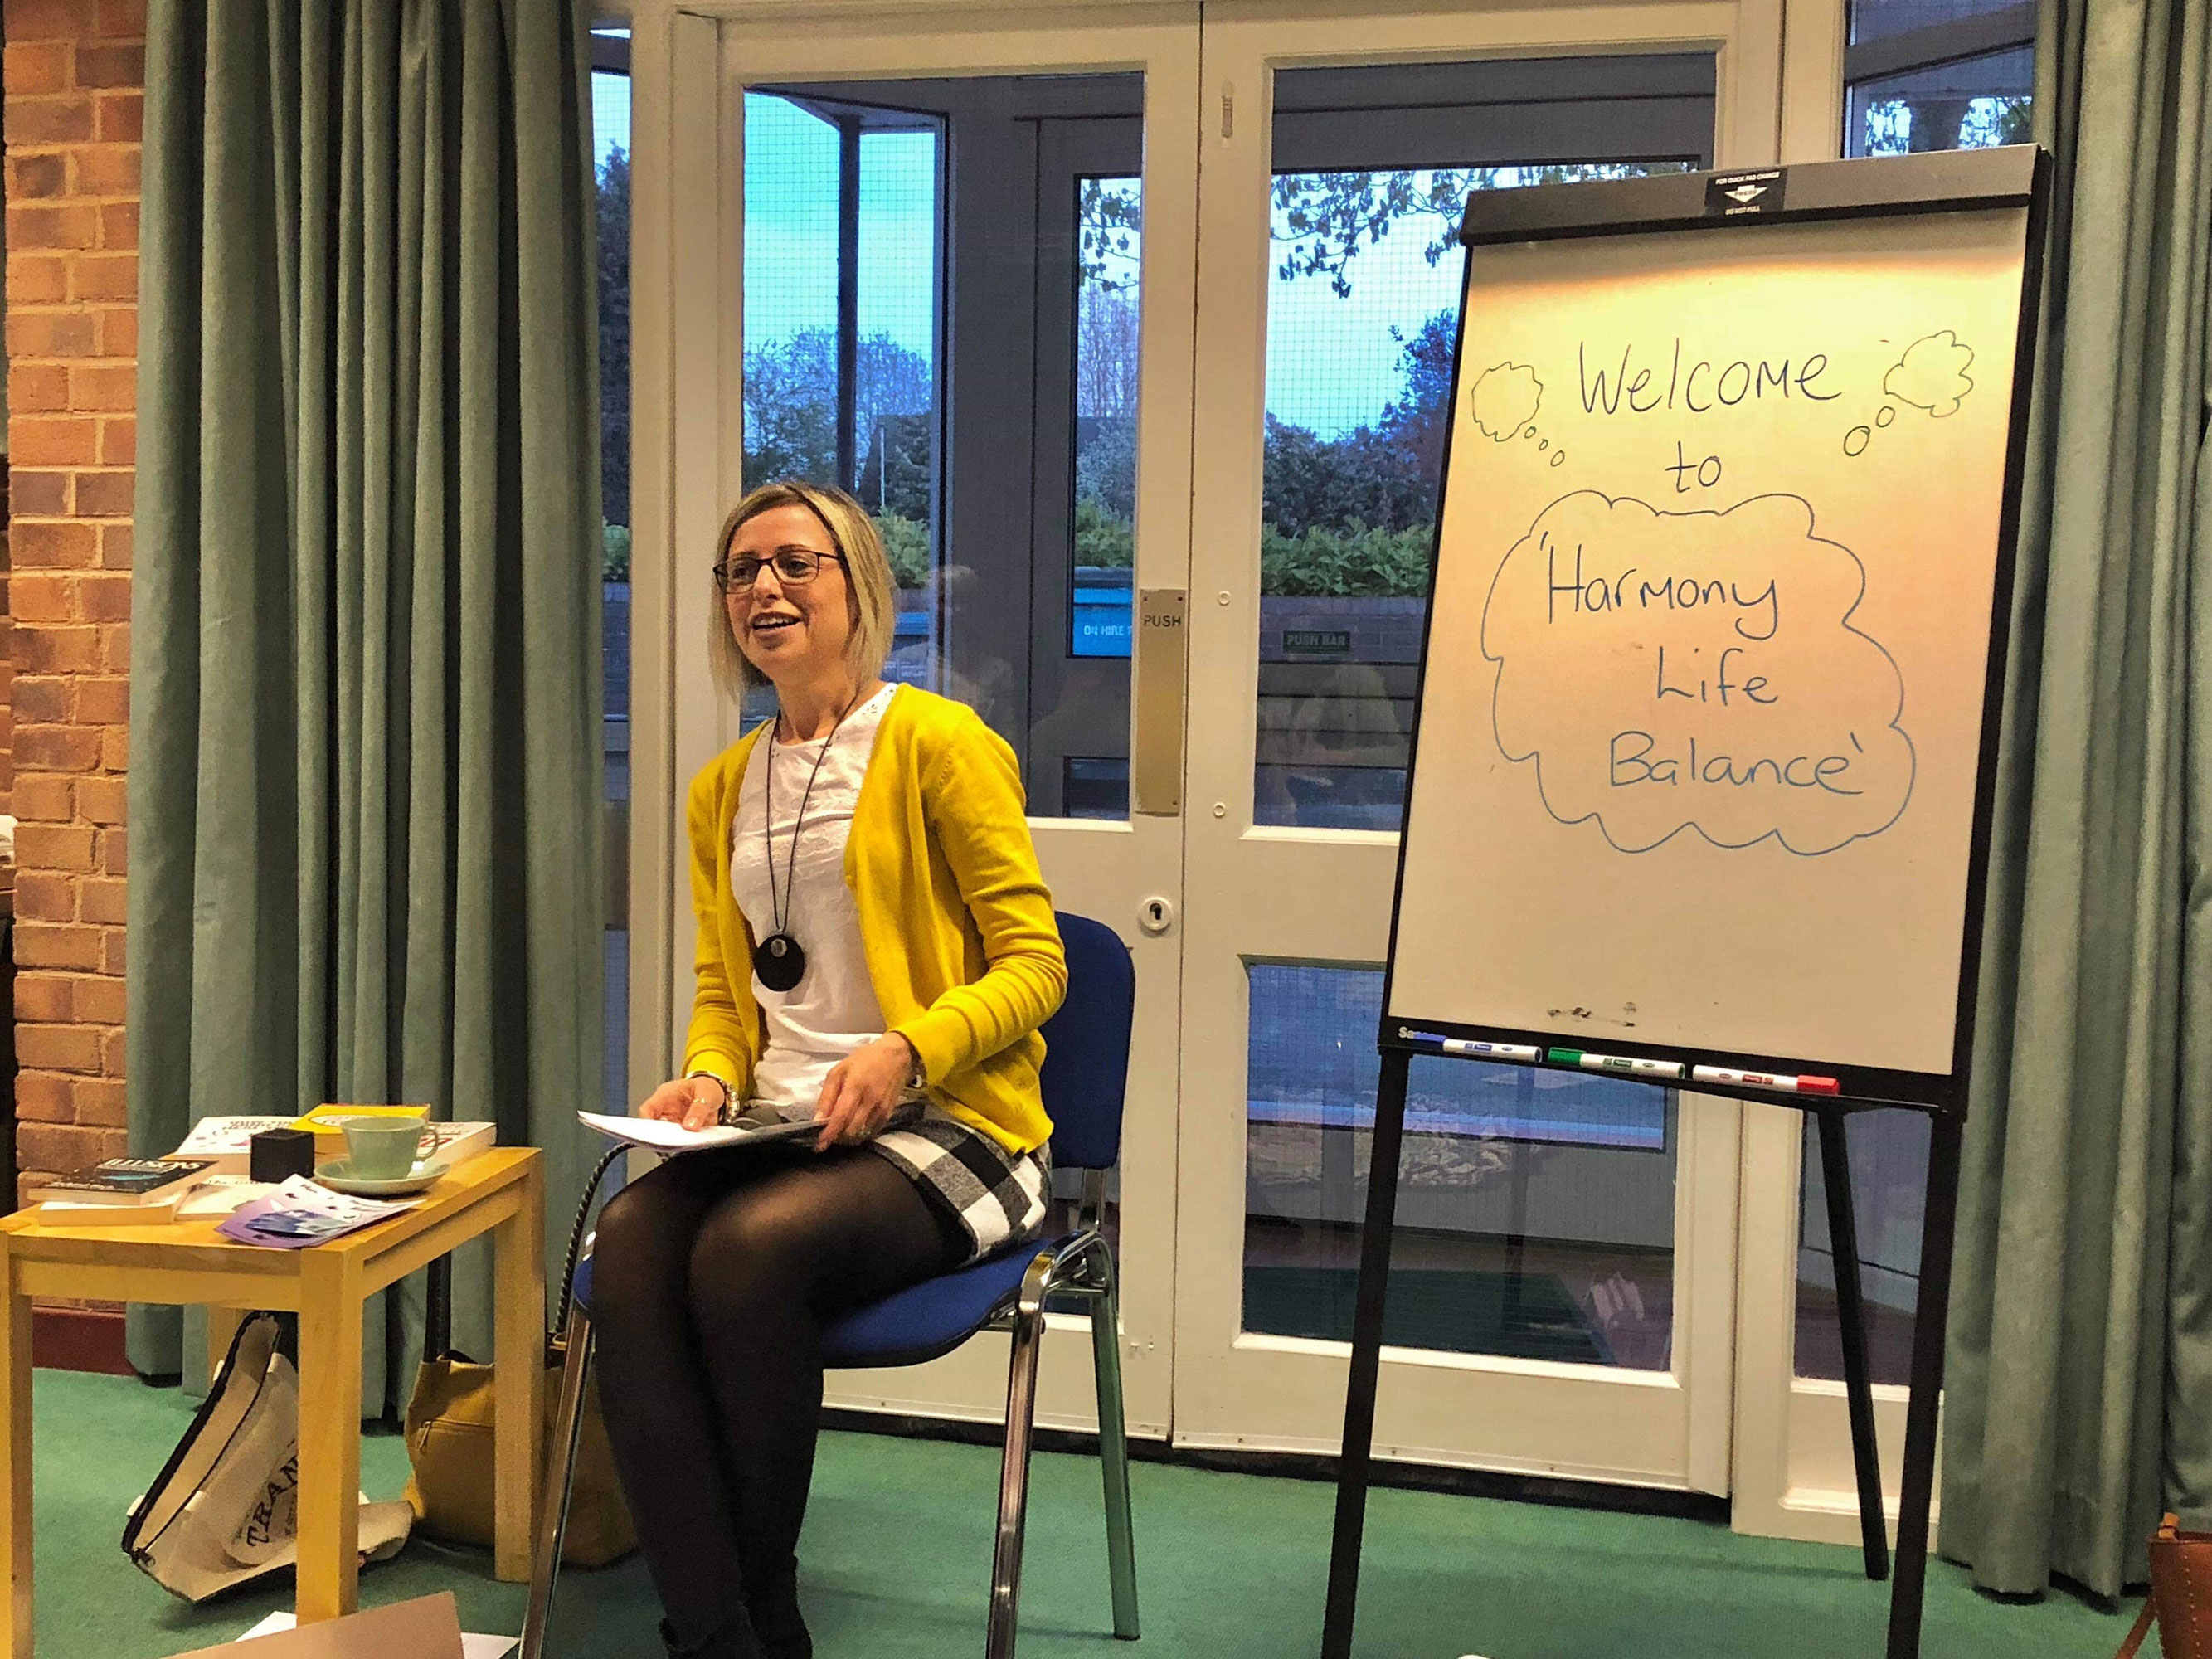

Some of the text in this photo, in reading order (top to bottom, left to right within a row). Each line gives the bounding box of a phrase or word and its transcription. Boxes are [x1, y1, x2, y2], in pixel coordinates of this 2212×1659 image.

[1728, 176, 1745, 184] QUICK
[1757, 171, 1781, 180] CHANGE
[1579, 337, 1842, 413] Welcome
[1665, 441, 1722, 492] to
[1101, 625, 1125, 636] HIRE
[1144, 615, 1182, 627] PUSH
[1657, 646, 1778, 705] Life
